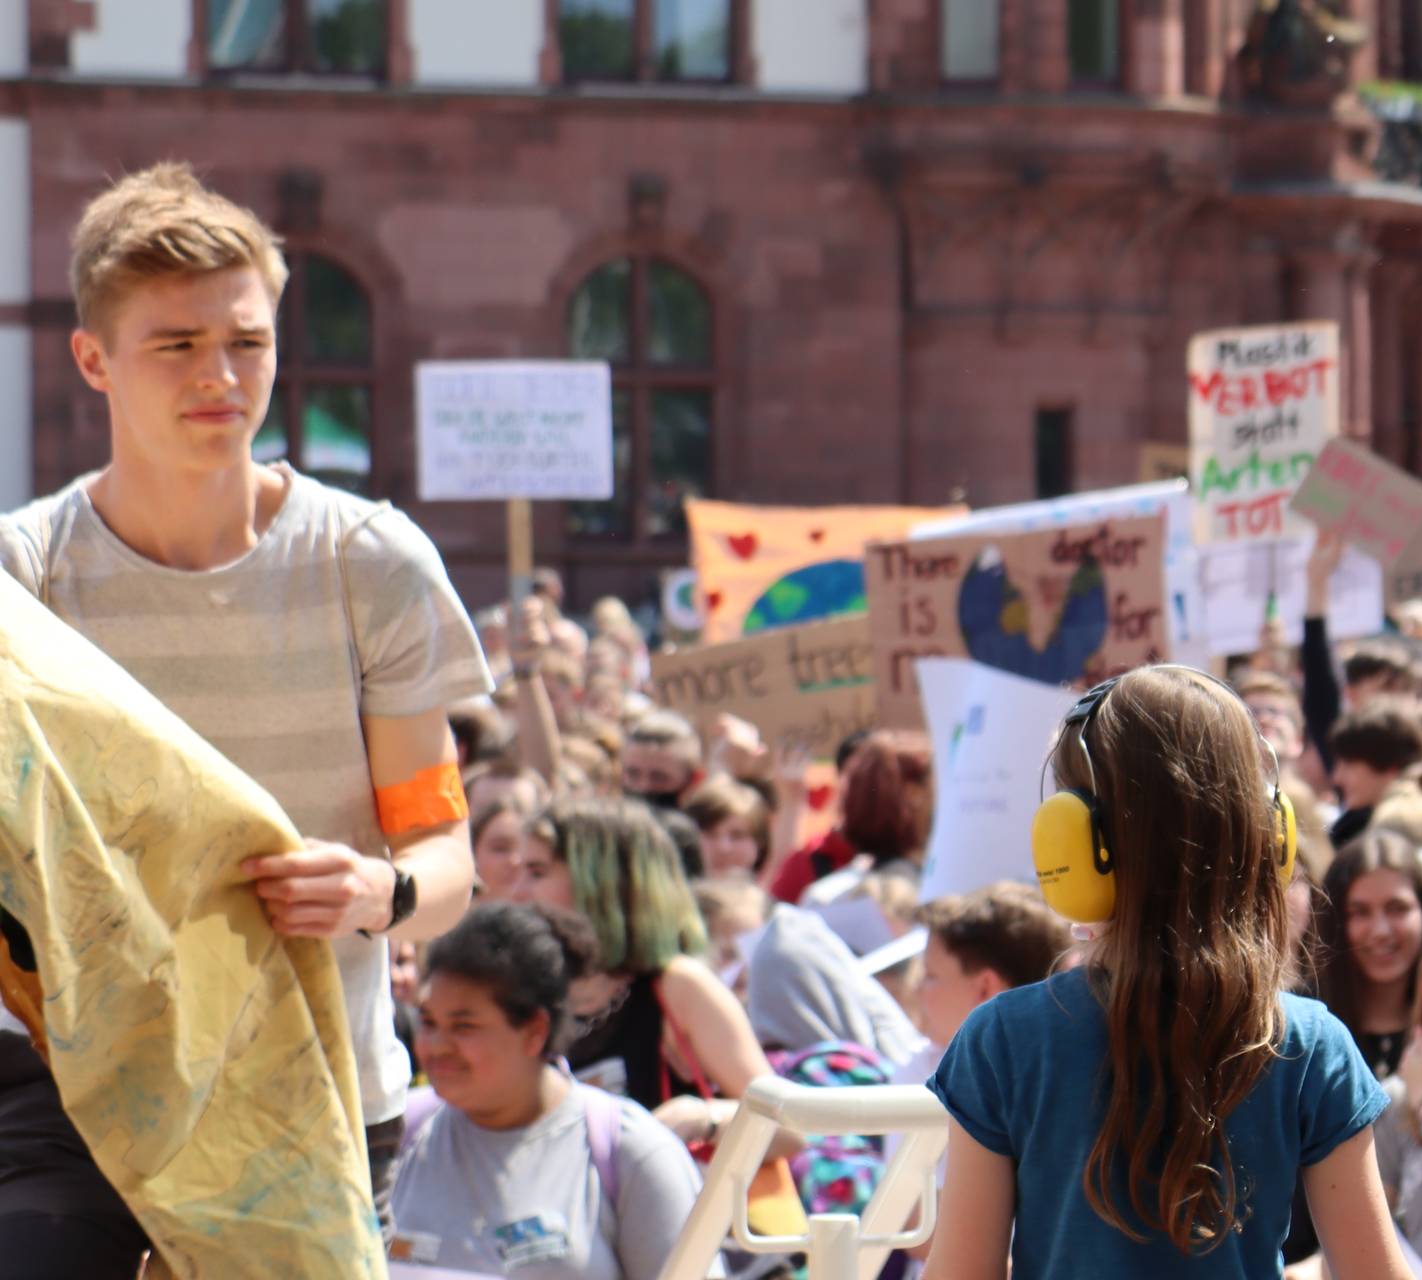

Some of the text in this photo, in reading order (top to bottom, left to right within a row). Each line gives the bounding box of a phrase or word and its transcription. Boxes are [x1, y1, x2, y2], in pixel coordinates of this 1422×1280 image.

[1190, 358, 1335, 416] VERBOT
[1200, 449, 1317, 502] Arten
[1217, 490, 1294, 537] TOT
[868, 543, 958, 583] There
[900, 583, 937, 637] is
[1107, 593, 1164, 642] for
[657, 653, 768, 708] more
